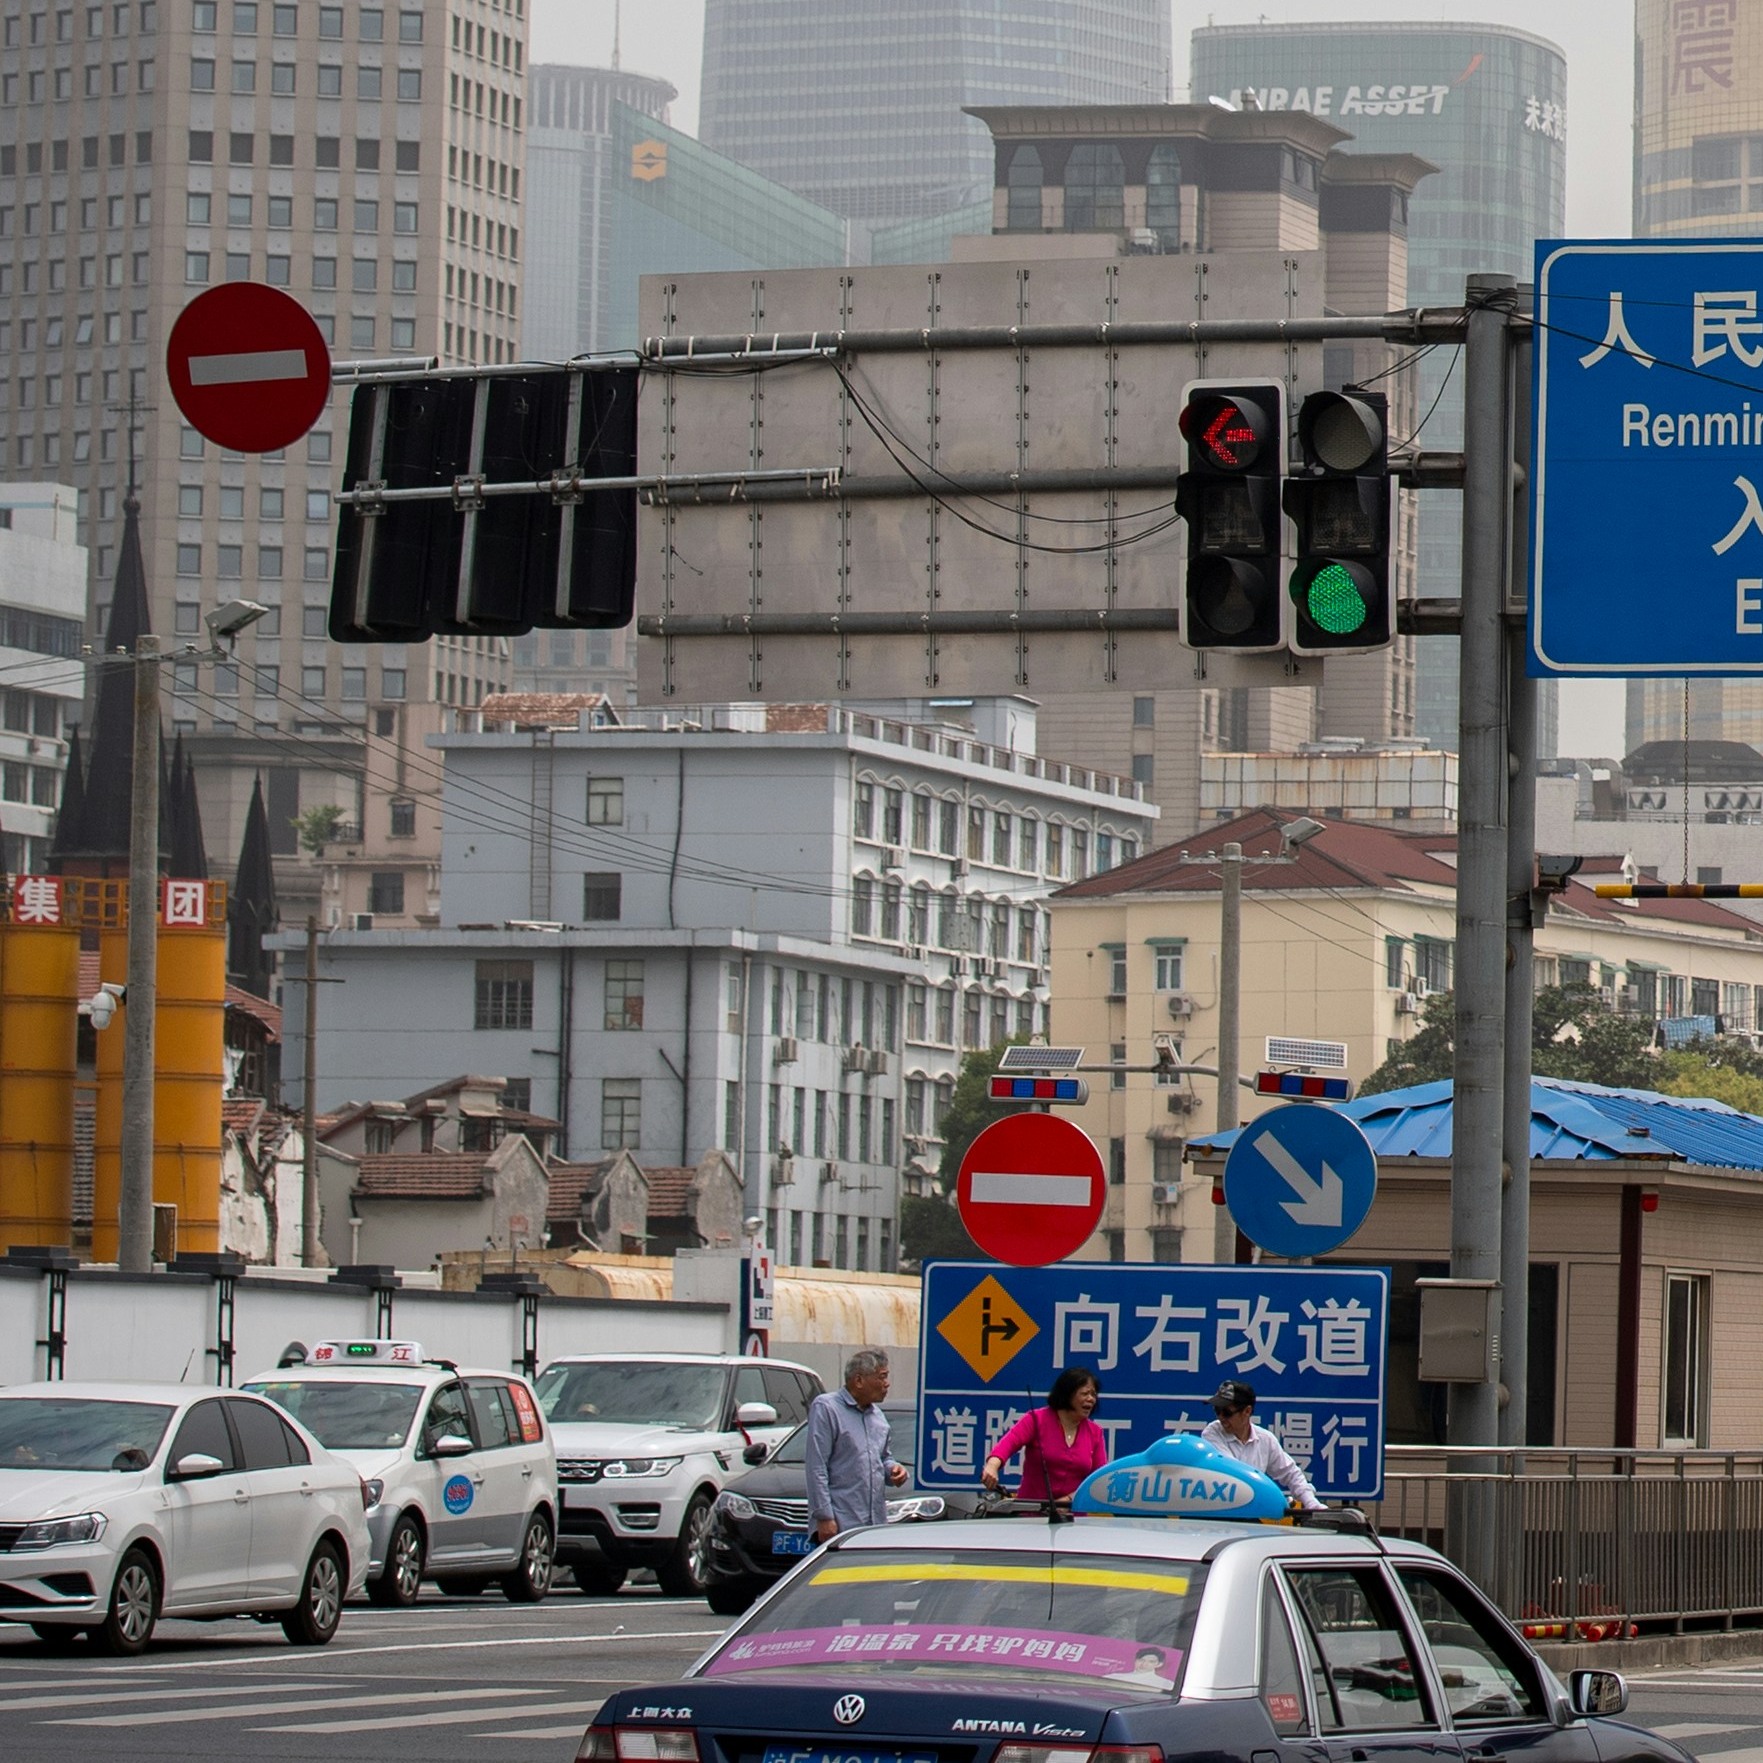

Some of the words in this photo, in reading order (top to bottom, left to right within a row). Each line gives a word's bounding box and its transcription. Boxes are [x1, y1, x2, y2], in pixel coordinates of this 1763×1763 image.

[1340, 85, 1450, 116] ASSET
[1052, 1293, 1371, 1376] 向右改道
[1107, 1471, 1170, 1503] 衡山
[1179, 1477, 1237, 1503] TAXI
[927, 1633, 1087, 1663] 只找驴妈妈
[952, 1718, 1026, 1733] ANTANA
[1032, 1723, 1086, 1737] Vista
